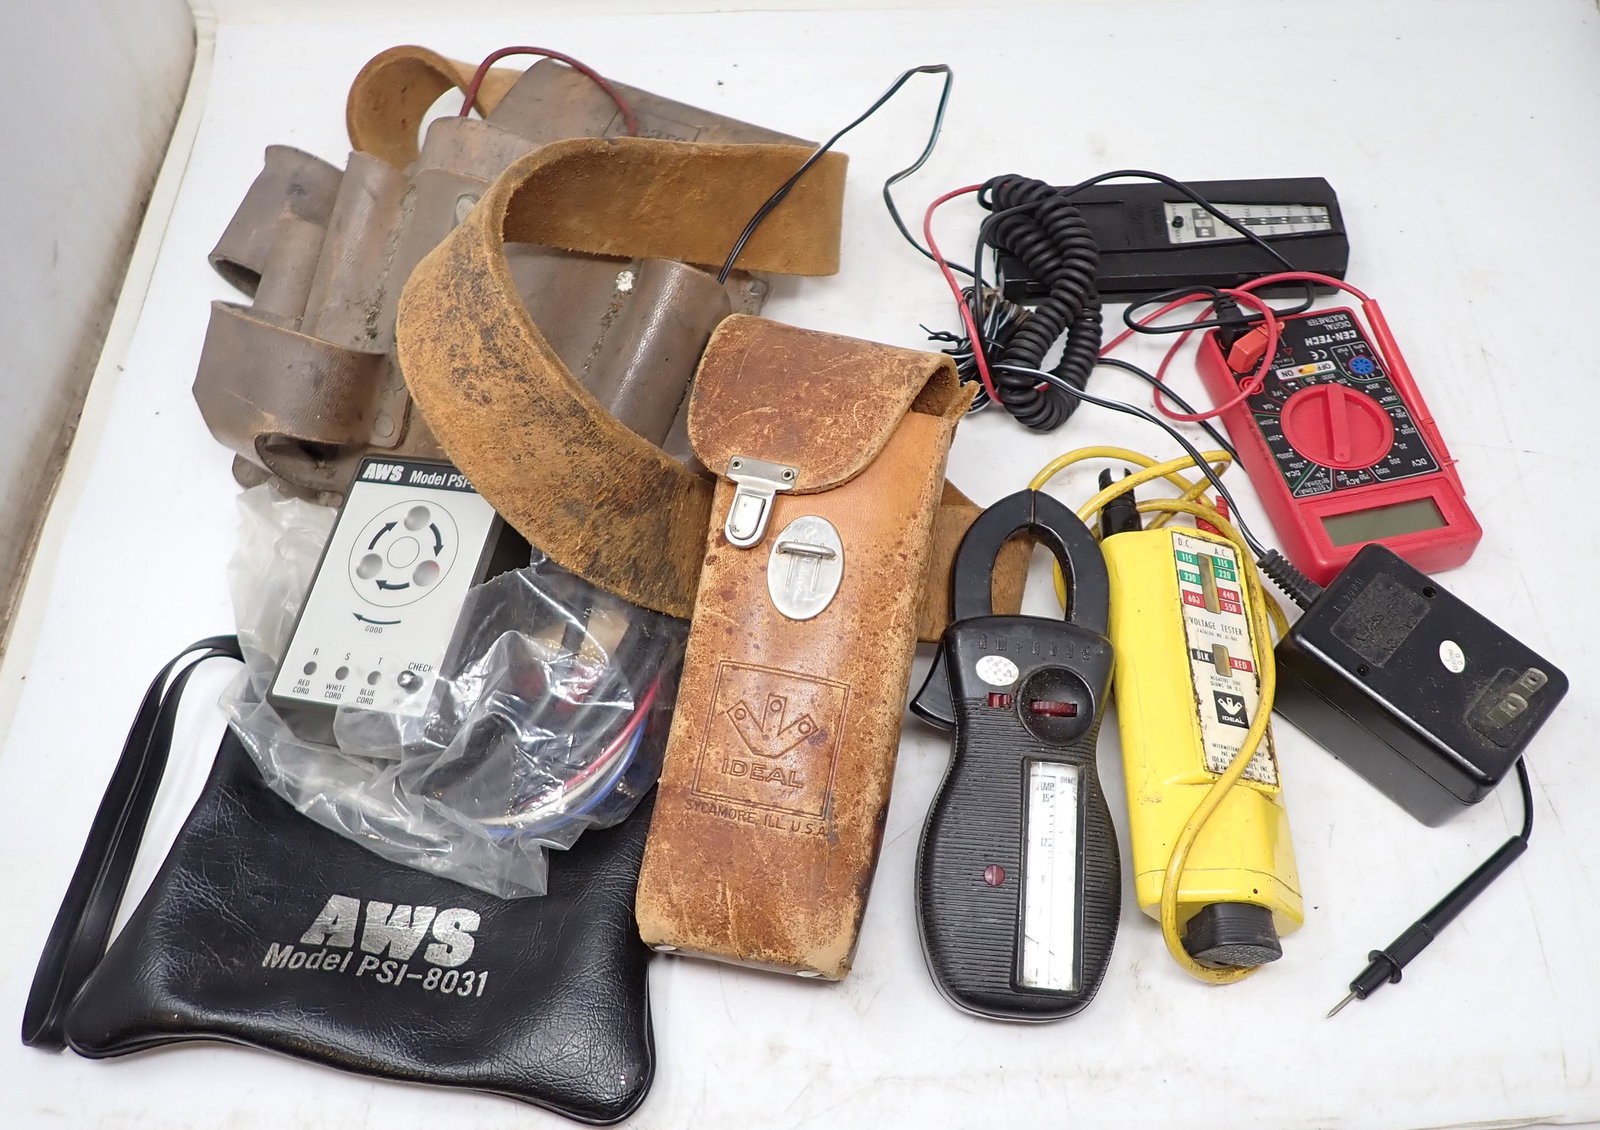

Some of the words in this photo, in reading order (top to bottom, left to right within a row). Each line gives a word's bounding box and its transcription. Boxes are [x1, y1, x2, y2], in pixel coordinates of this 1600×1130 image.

[1306, 314, 1348, 326] MULTIMETER
[1324, 320, 1351, 330] DIGITAL
[1304, 330, 1357, 346] CEN-TECH
[1411, 458, 1427, 466] DCV
[362, 462, 404, 482] AWS
[408, 470, 447, 486] Model
[447, 474, 477, 490] PSI-
[1182, 553, 1193, 562] 115
[1217, 558, 1228, 568] 115
[1184, 574, 1197, 582] 230
[1218, 570, 1232, 580] 220
[1222, 592, 1235, 600] 440
[1224, 604, 1237, 612] 550
[364, 625, 383, 634] GOOD
[1190, 617, 1216, 630] VOLTAGE
[1221, 624, 1243, 636] TESTER
[313, 648, 320, 656] R
[345, 652, 351, 661] S
[1196, 650, 1210, 662] BLK
[378, 656, 384, 665] T
[1233, 660, 1248, 670] RED
[408, 662, 433, 673] CHECK
[297, 678, 310, 687] RED
[292, 686, 310, 696] CORD
[326, 683, 346, 693] WHITE
[359, 688, 375, 698] BLUE
[324, 691, 342, 701] CORD
[356, 696, 374, 706] CORD
[1222, 716, 1246, 724] IDEAL
[721, 758, 803, 788] IDEAL
[1042, 794, 1050, 802] 15
[764, 814, 786, 830] ILL.
[300, 894, 481, 967] AWS
[262, 942, 353, 974] Model
[356, 955, 489, 998] PSI-8031
